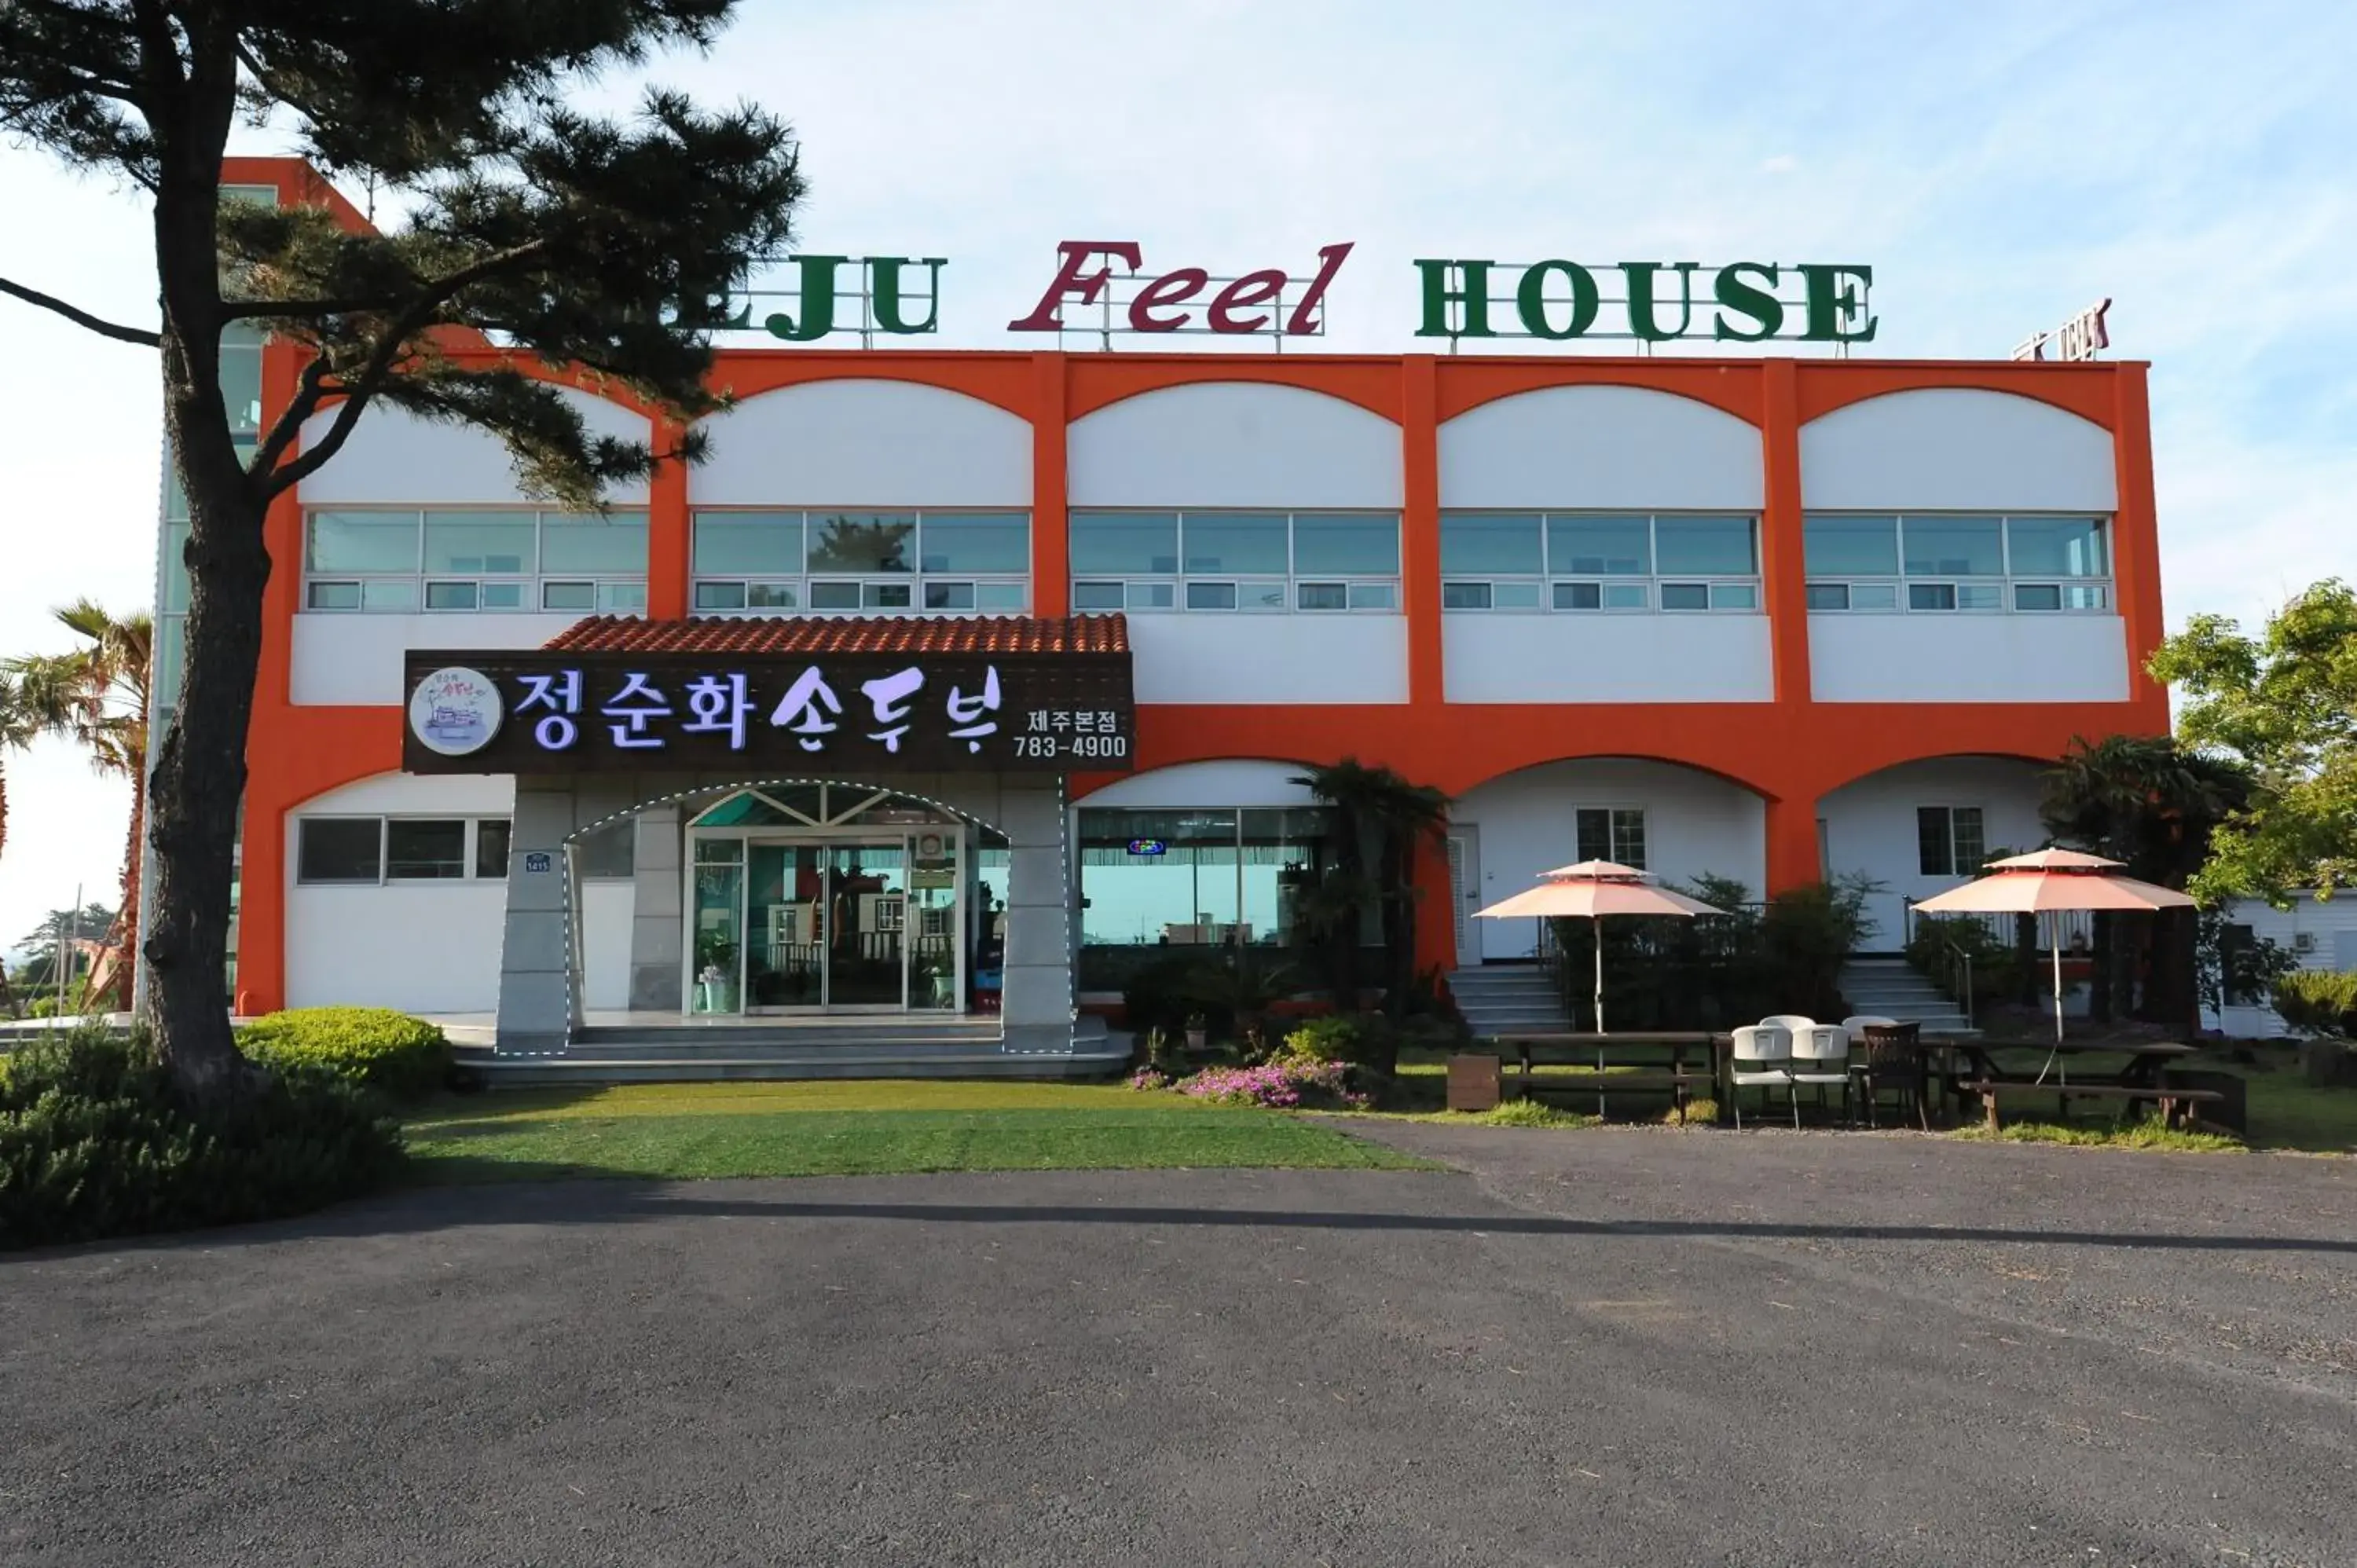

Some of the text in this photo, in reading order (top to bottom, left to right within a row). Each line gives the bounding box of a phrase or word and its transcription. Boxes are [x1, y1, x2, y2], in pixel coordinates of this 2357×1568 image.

[1007, 241, 1355, 334] Feel
[1413, 258, 1878, 342] HOUSE
[514, 665, 1000, 753] 정순화 손두부
[1028, 709, 1116, 733] 제주본점
[1013, 736, 1127, 757] 783-4900
